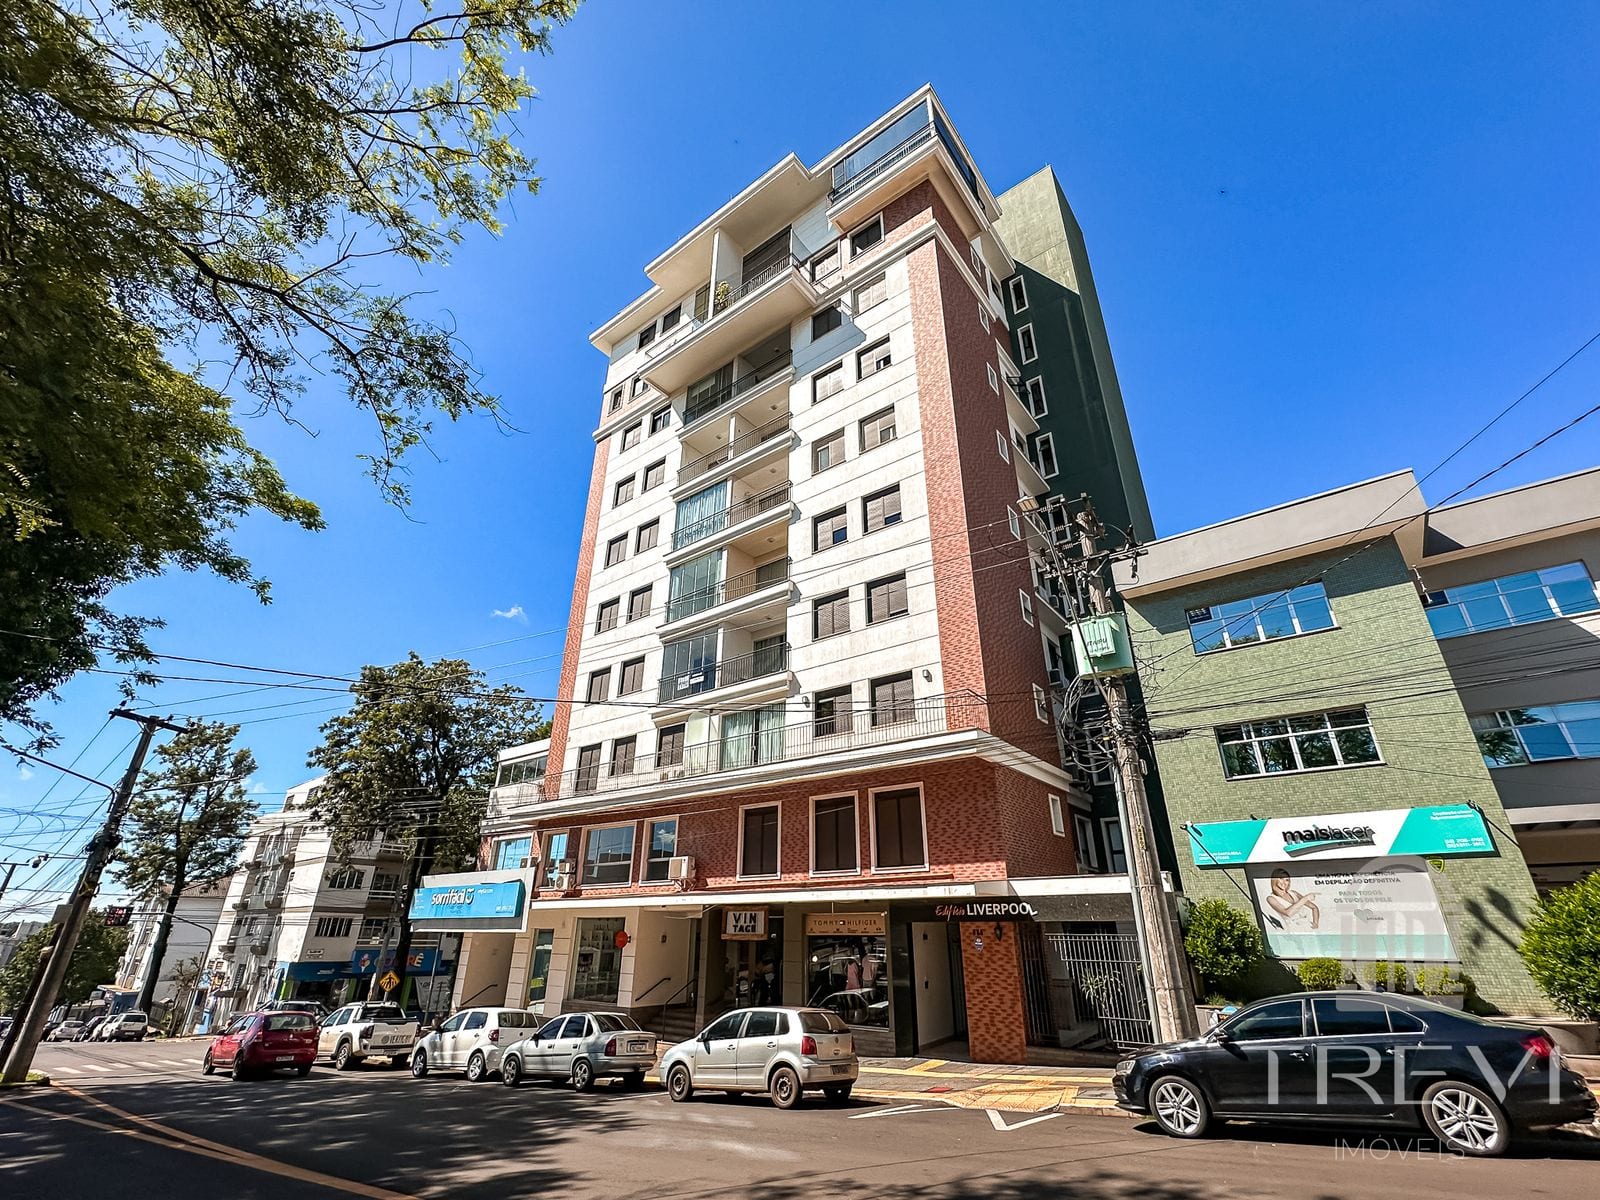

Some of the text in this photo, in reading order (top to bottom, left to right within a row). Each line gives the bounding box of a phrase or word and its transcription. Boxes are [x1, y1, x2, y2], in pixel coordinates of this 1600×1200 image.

[967, 902, 1038, 916] LIVERPOOL
[733, 912, 757, 924] VIN
[814, 918, 877, 927] TOMMY HILFIGER
